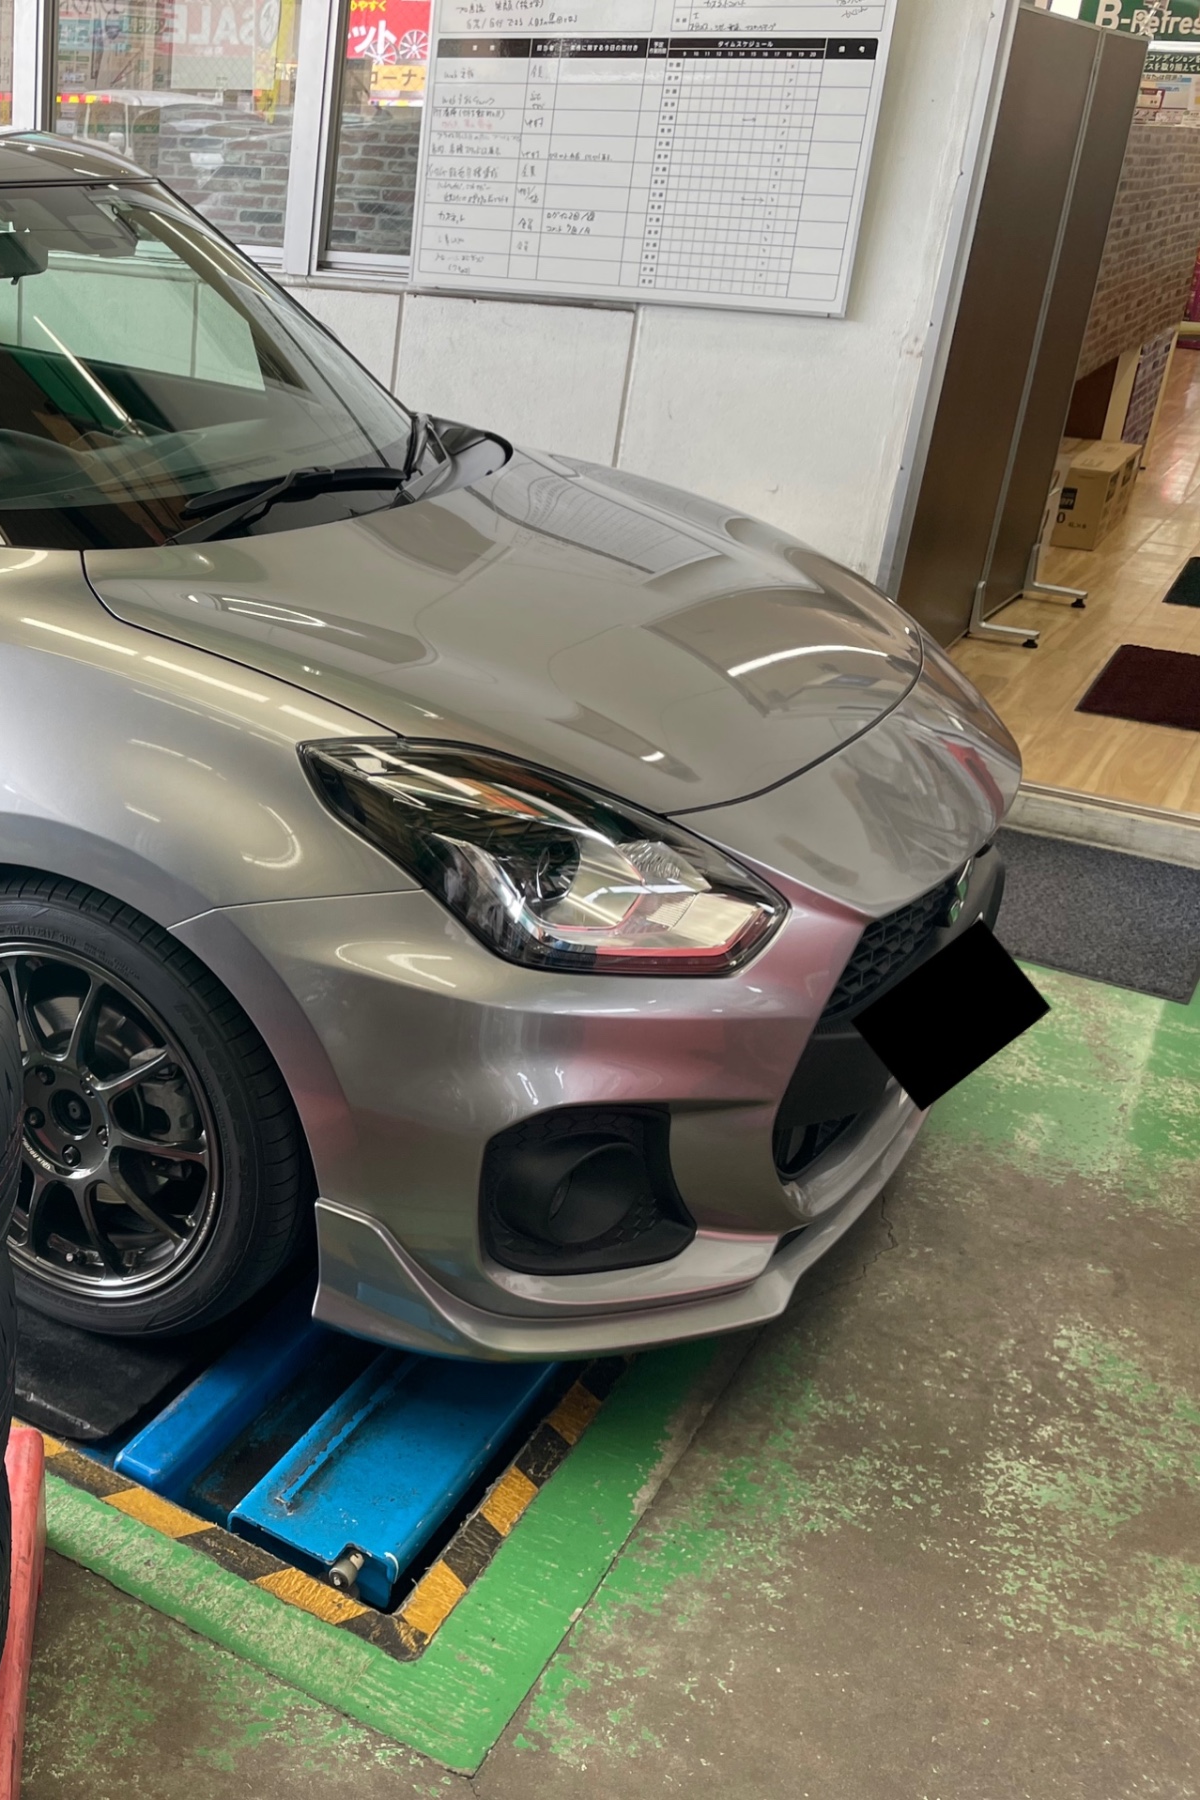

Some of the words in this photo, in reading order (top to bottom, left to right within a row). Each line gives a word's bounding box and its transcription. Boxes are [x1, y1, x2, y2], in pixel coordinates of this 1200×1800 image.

[348, 19, 398, 57] ット
[1146, 54, 1200, 63] コンディション
